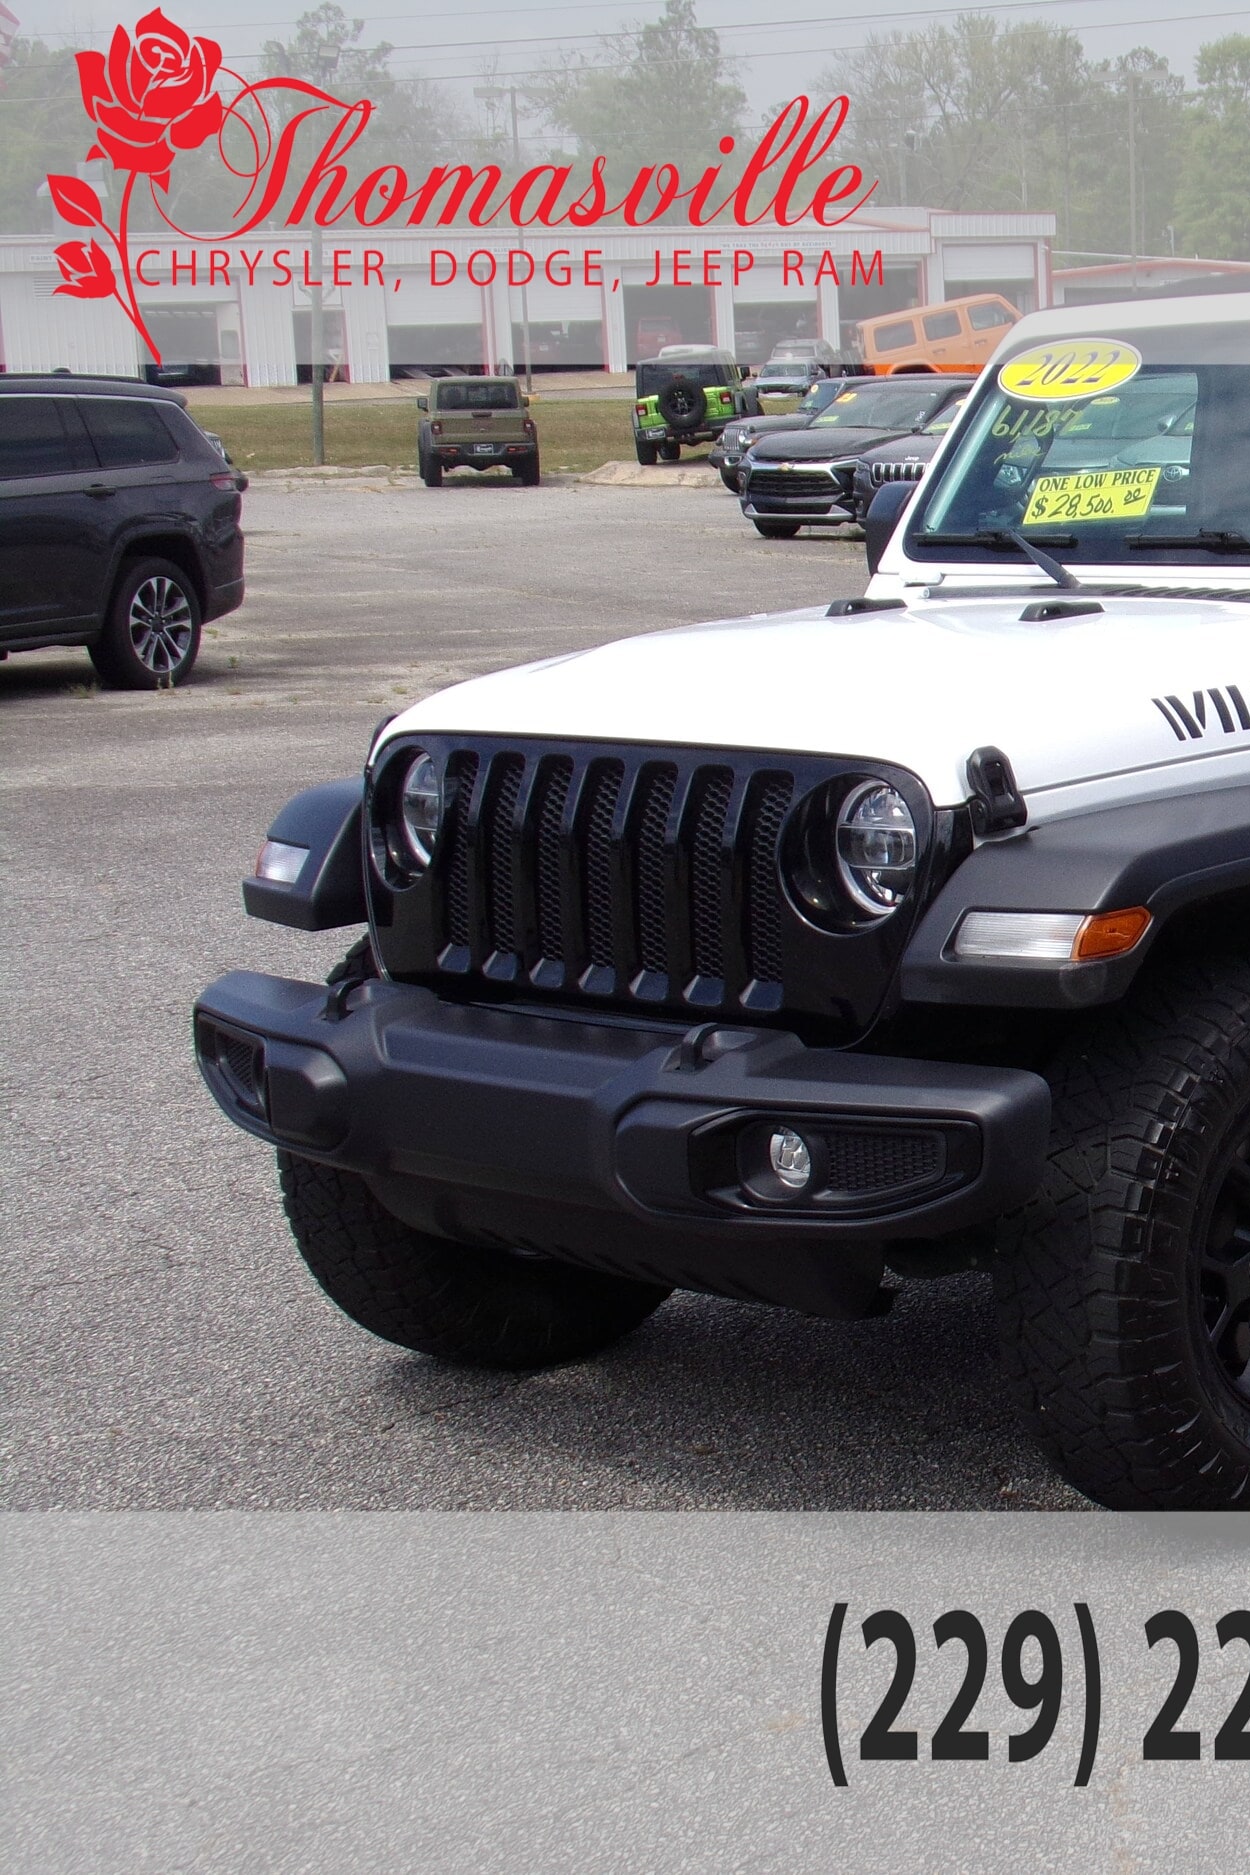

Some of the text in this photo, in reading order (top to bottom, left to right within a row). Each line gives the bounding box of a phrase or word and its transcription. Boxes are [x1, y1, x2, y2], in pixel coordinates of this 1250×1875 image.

[1014, 350, 1121, 386] 2022
[1038, 468, 1157, 493] ONE LOW PRICE
